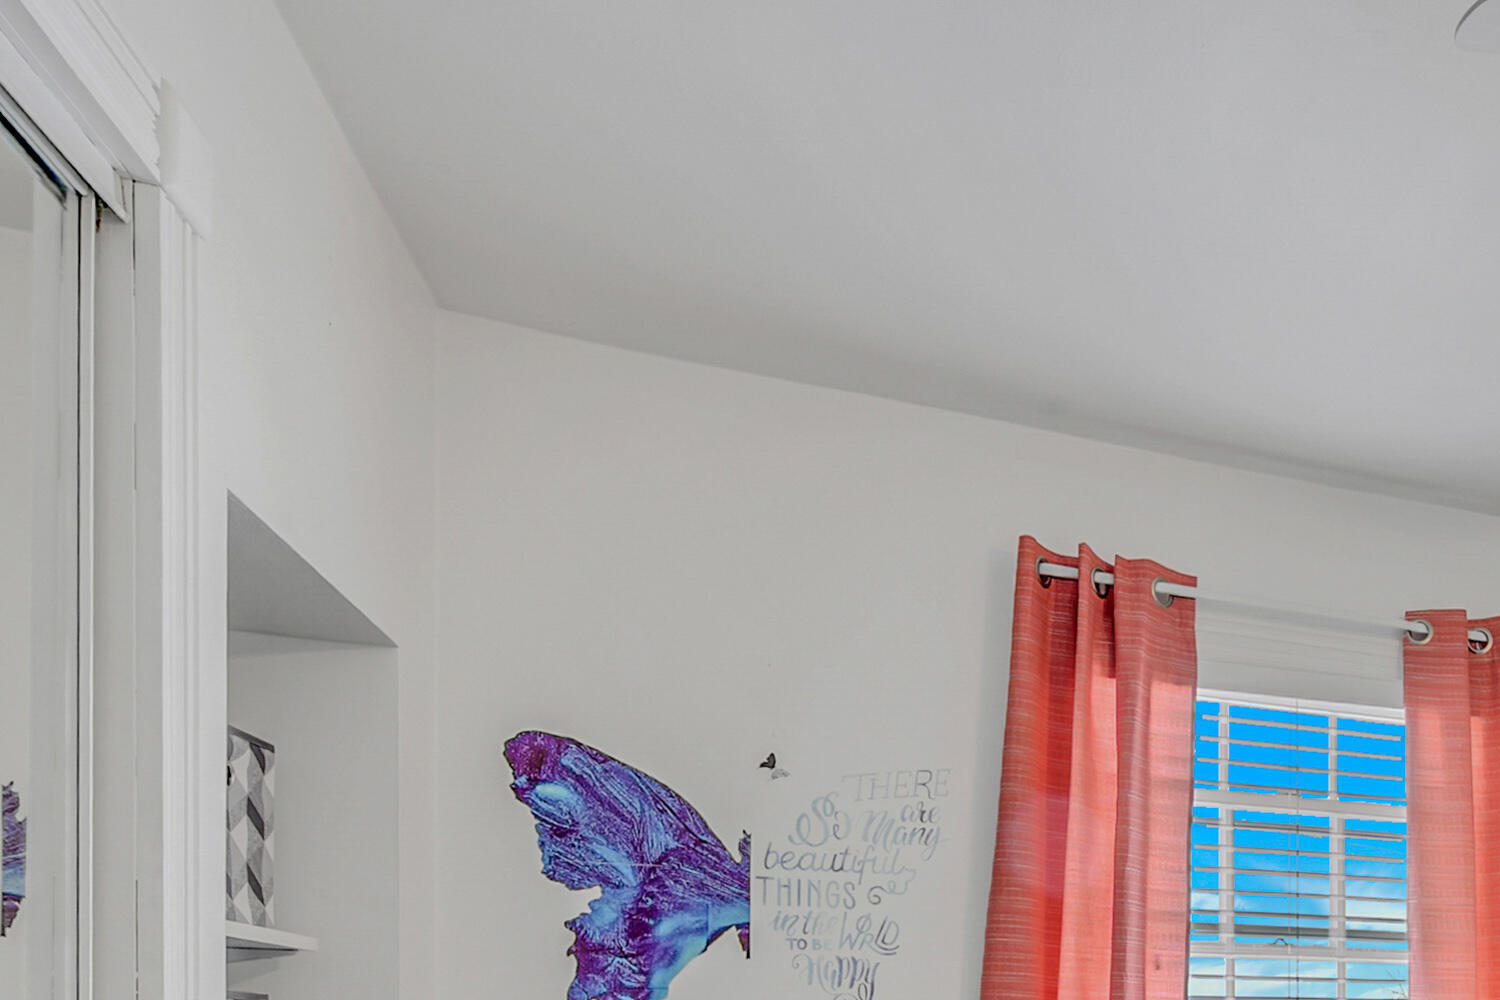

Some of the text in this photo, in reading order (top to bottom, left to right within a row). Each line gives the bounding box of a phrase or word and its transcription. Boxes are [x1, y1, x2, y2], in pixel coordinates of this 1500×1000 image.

[842, 768, 951, 801] THERE
[900, 801, 941, 824] are
[861, 809, 941, 861] Many
[764, 842, 912, 885] beautiful
[755, 875, 857, 910] THINGS
[785, 938, 808, 951] TO
